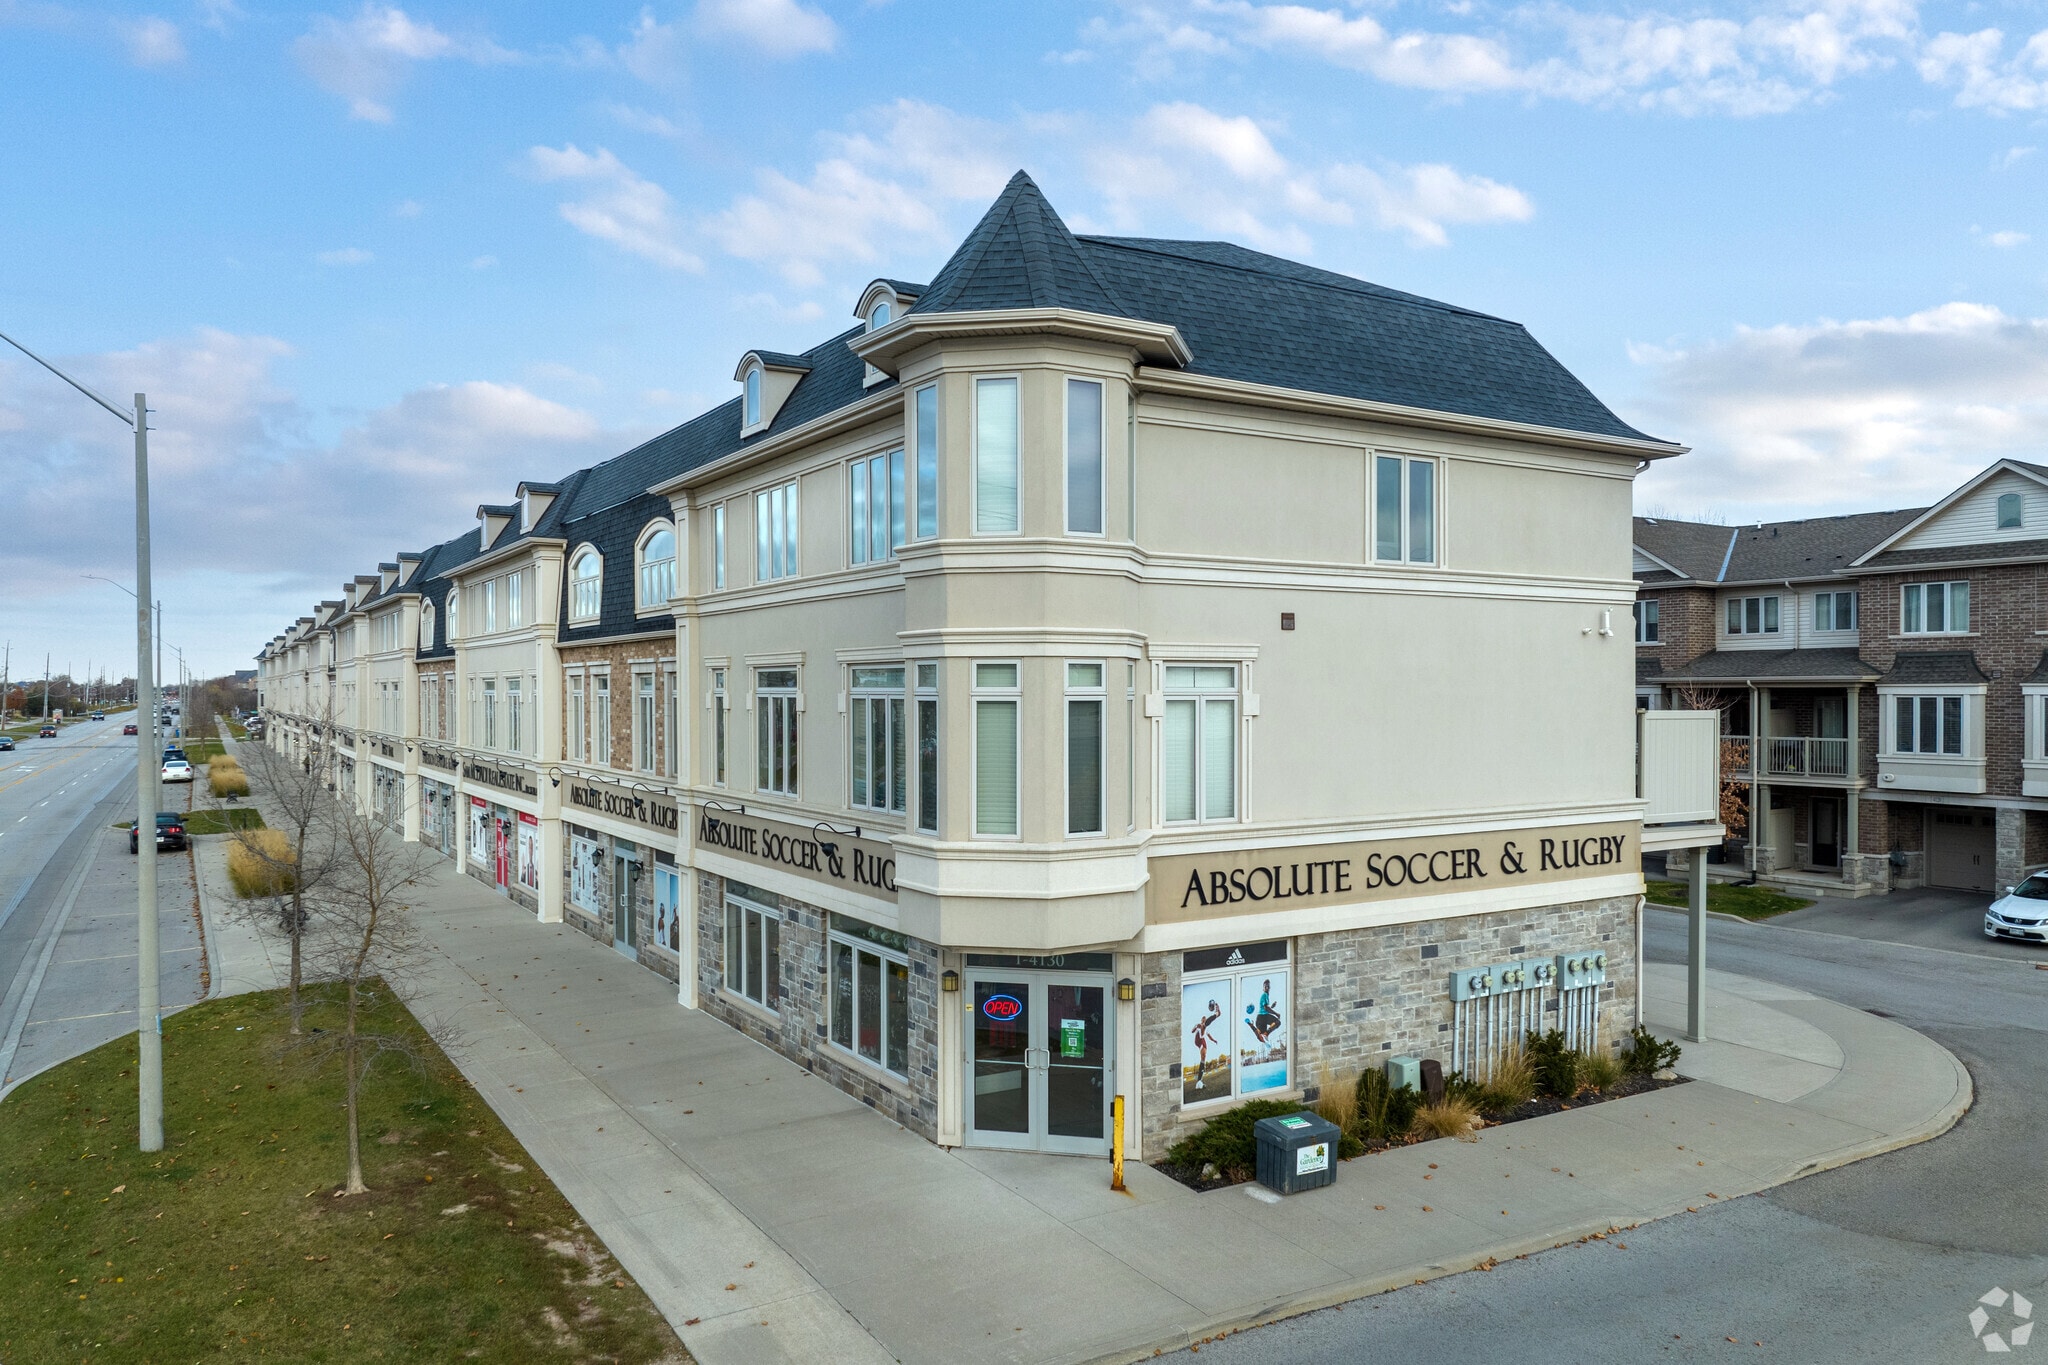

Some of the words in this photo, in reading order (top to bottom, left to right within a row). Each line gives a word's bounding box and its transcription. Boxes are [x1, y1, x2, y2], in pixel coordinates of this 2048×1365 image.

[570, 783, 602, 811] ABSOLUTE
[604, 790, 636, 820] SOCCER
[650, 801, 679, 830] RUGB
[699, 815, 758, 856] ABSOLUTE
[762, 828, 823, 873] SOCCER
[828, 843, 846, 879] &
[853, 848, 899, 893] RUG
[1180, 859, 1352, 908] ABSOLUTE
[1366, 848, 1488, 889] SOCCER
[1500, 841, 1527, 875] &
[1539, 834, 1626, 871] RUGBY
[1016, 954, 1065, 967] 1-4130
[1225, 957, 1246, 966] adidas
[985, 1000, 1019, 1016] OPEN
